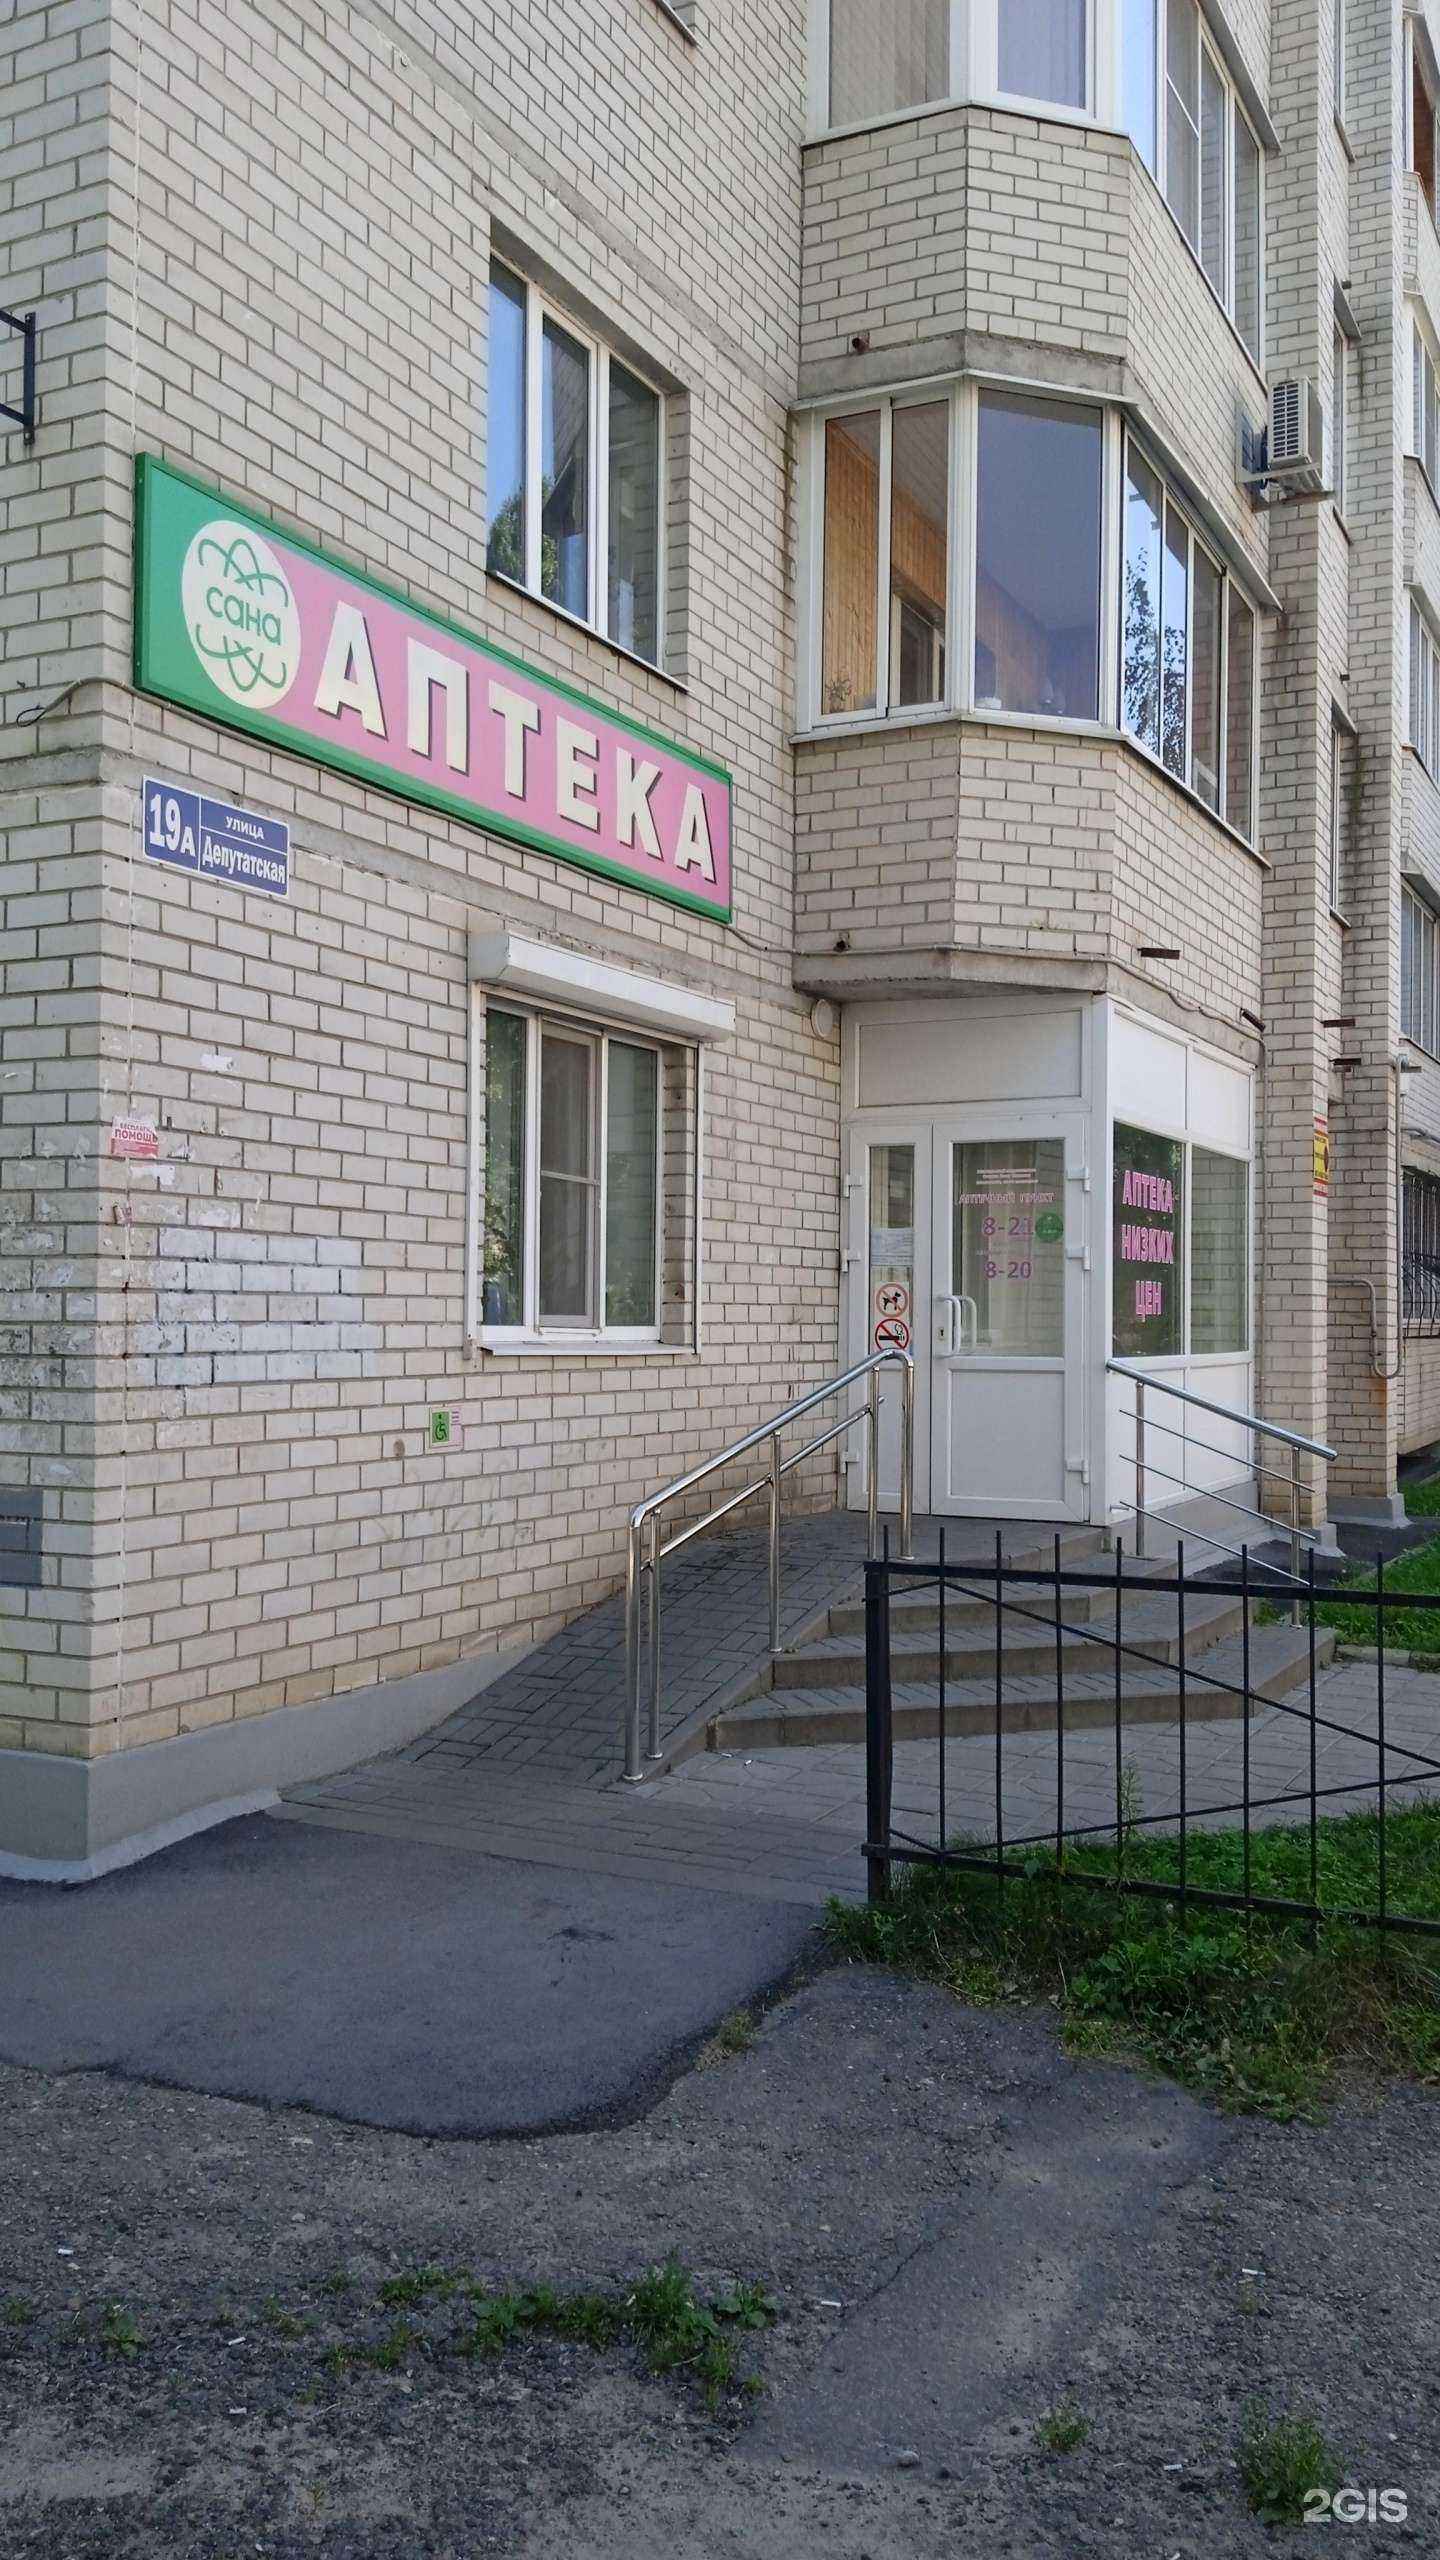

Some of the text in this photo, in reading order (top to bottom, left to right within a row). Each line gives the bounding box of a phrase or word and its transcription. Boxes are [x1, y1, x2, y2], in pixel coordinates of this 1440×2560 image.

[313, 600, 717, 883] АПТЕКА
[202, 835, 286, 884] Депутатская
[1122, 1169, 1174, 1213] АПТЕКА
[1121, 1224, 1174, 1264] НИЗКИХ
[985, 1261, 1032, 1279] 8-20
[1135, 1280, 1162, 1322] ЦЕН
